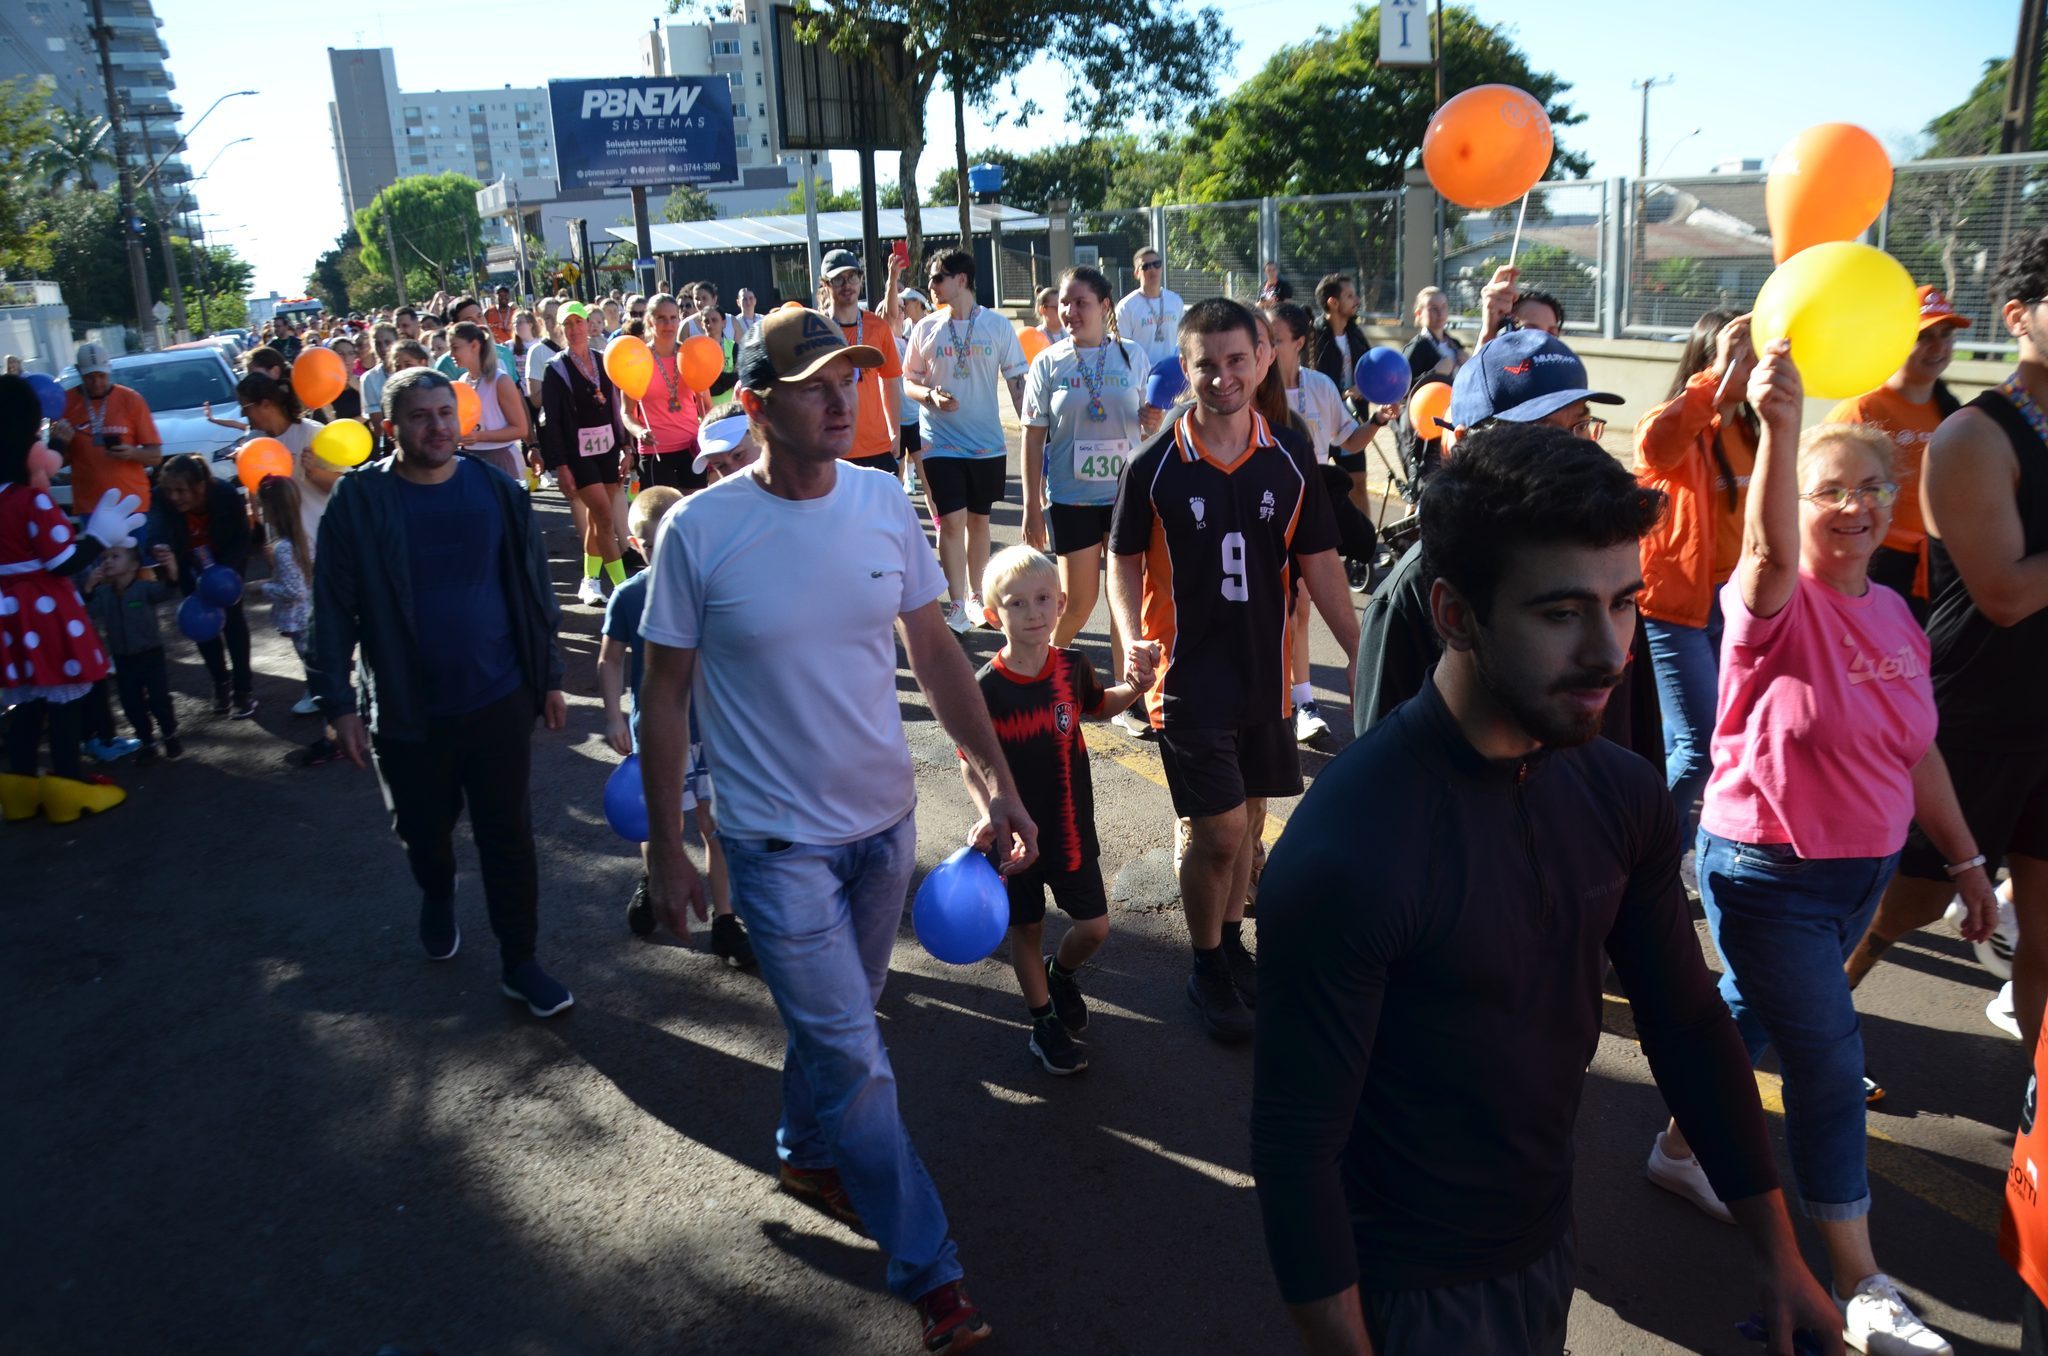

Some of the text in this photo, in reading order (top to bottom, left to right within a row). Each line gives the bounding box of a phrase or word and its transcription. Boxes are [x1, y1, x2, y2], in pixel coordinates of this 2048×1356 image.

[582, 86, 702, 118] PBNEW
[612, 116, 705, 132] SISTEMAS
[606, 136, 687, 149] Soluções tecnológicas
[619, 146, 652, 158] produtos
[683, 162, 721, 173] 3744-3880
[584, 436, 609, 453] 411
[1081, 454, 1123, 478] 430
[1221, 531, 1249, 602] 9
